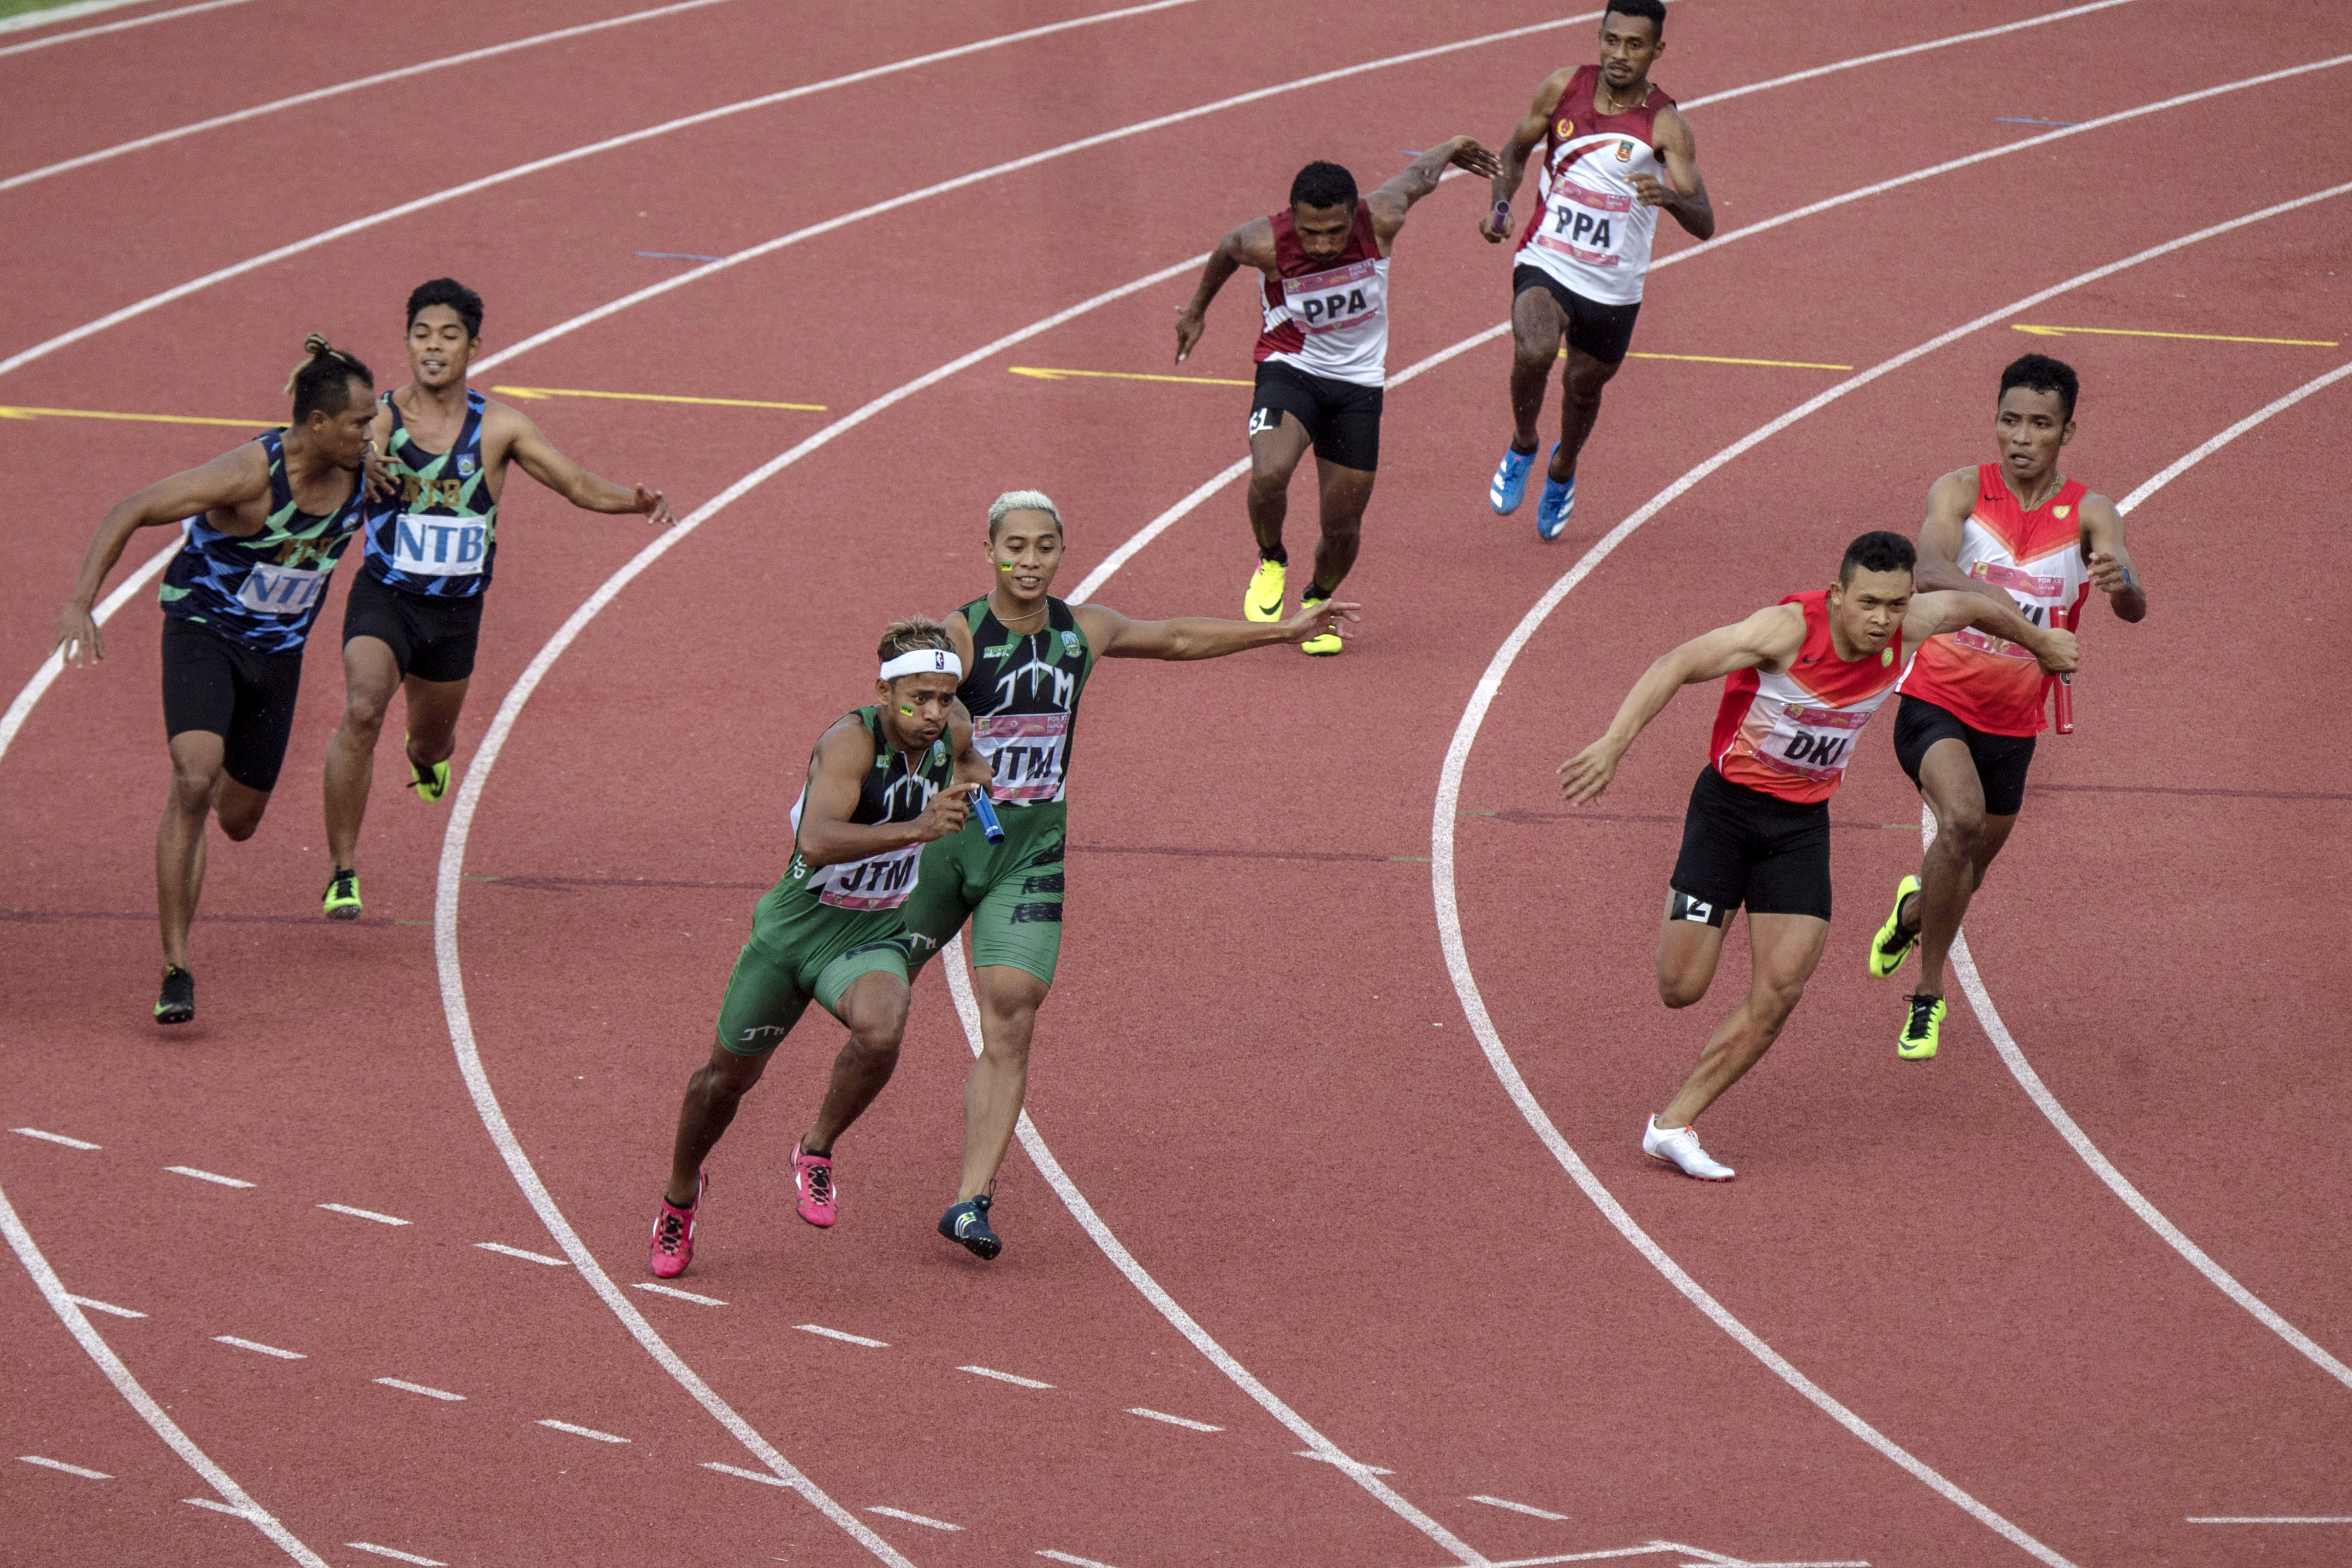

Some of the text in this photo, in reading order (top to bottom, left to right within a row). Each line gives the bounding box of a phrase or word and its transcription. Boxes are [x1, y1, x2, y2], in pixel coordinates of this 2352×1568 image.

[1555, 205, 1610, 248] PPA
[1302, 289, 1367, 323] PPA
[397, 521, 484, 563] NTB
[985, 658, 1074, 718] JTM
[1783, 730, 1849, 767] DKI
[841, 854, 916, 891] JTM
[910, 932, 938, 950] TM
[738, 1025, 785, 1041] JTM
